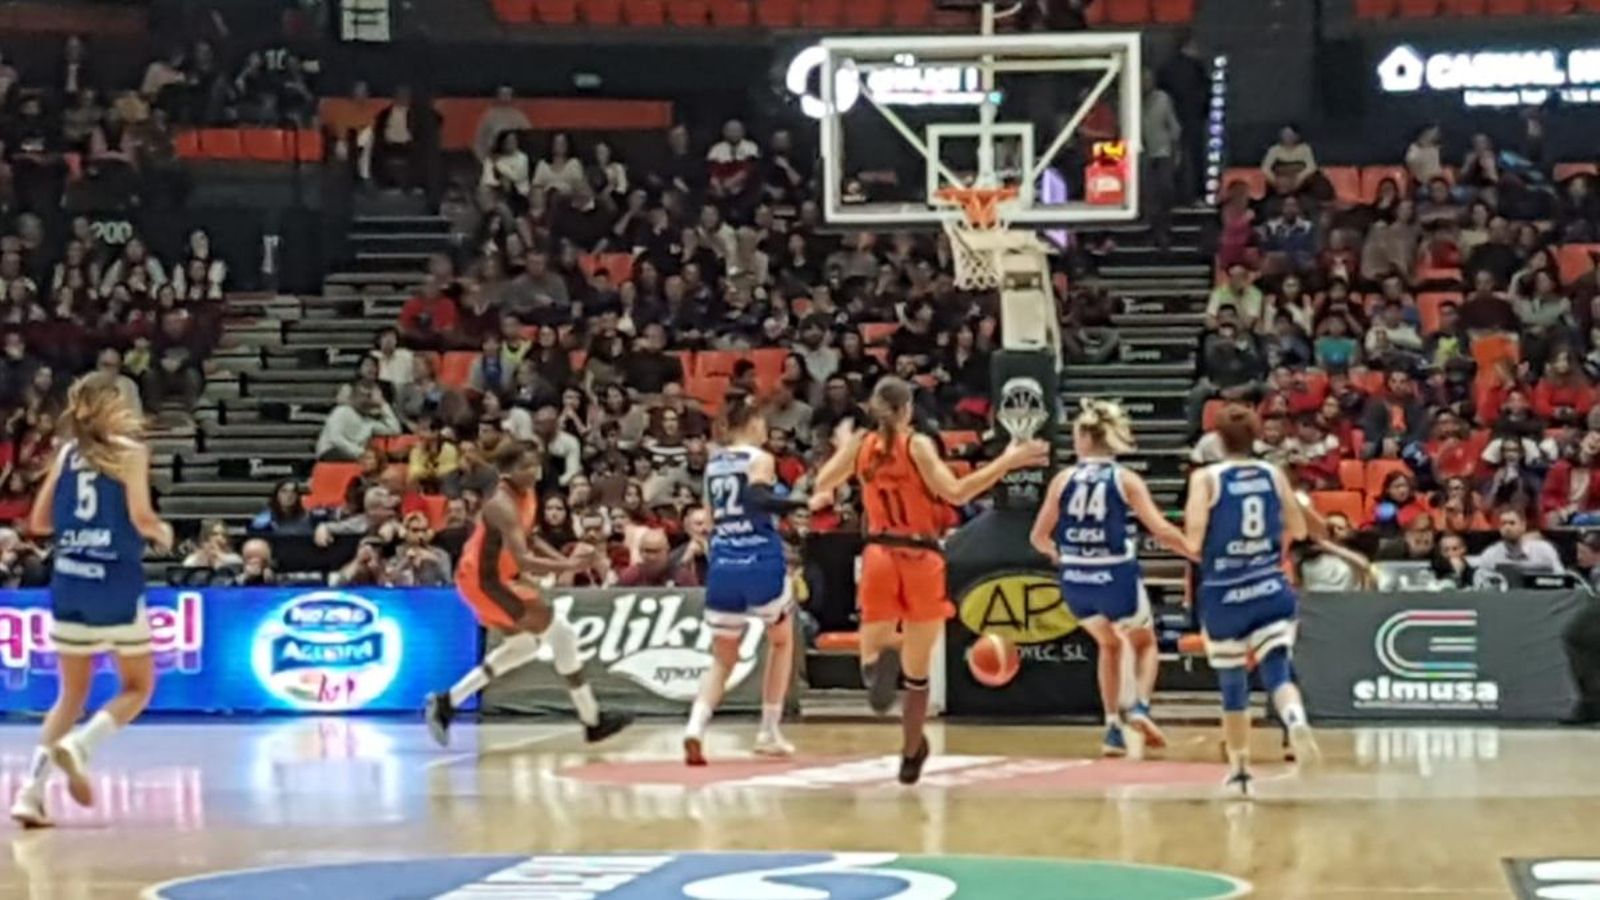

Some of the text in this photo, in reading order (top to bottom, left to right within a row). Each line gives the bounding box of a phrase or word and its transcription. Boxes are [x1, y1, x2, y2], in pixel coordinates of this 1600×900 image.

[74, 472, 98, 521] 5
[879, 488, 908, 527] 11
[1068, 480, 1107, 523] 44
[1240, 494, 1265, 538] 8
[1353, 675, 1499, 701] elmusa
